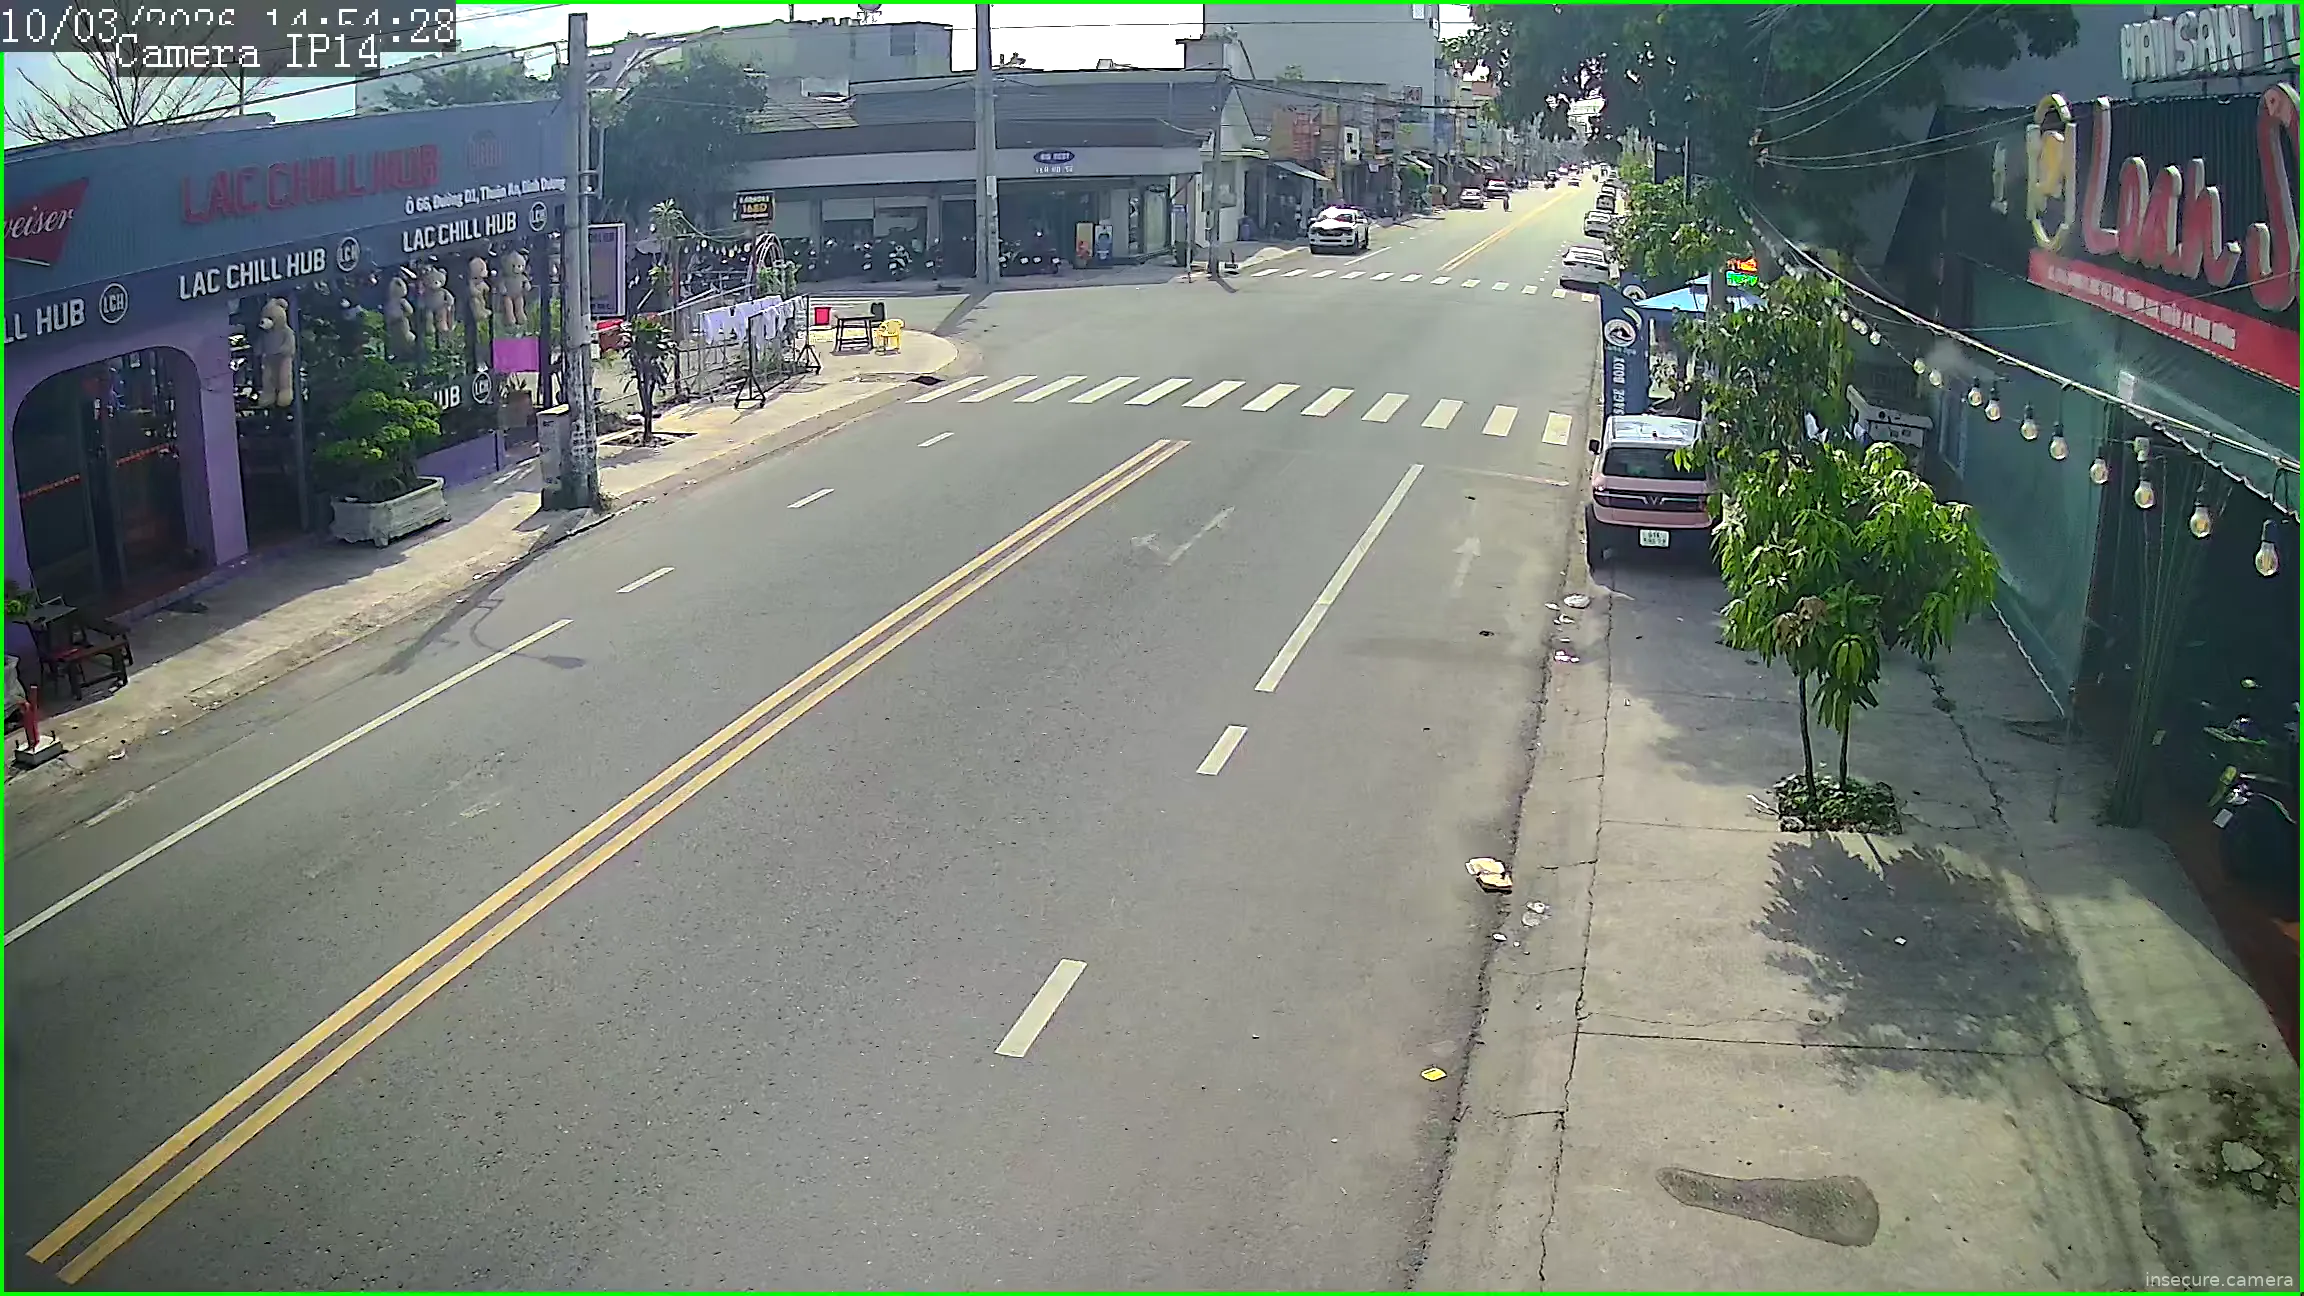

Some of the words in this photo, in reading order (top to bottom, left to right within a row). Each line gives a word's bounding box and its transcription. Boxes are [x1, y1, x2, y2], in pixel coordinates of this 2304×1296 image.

[182, 164, 262, 224] LAC
[267, 154, 366, 209] CHILL
[367, 145, 441, 195] HUB
[2082, 95, 2242, 288] Loan
[402, 226, 437, 253] LAC
[438, 218, 482, 245] CHILL
[485, 211, 517, 236] HUB
[178, 268, 221, 300] LAC
[226, 257, 282, 290] CHILL
[287, 248, 326, 277] HUB
[36, 298, 86, 335] HUB
[103, 293, 125, 313] LCH
[1612, 356, 1626, 384] BODY
